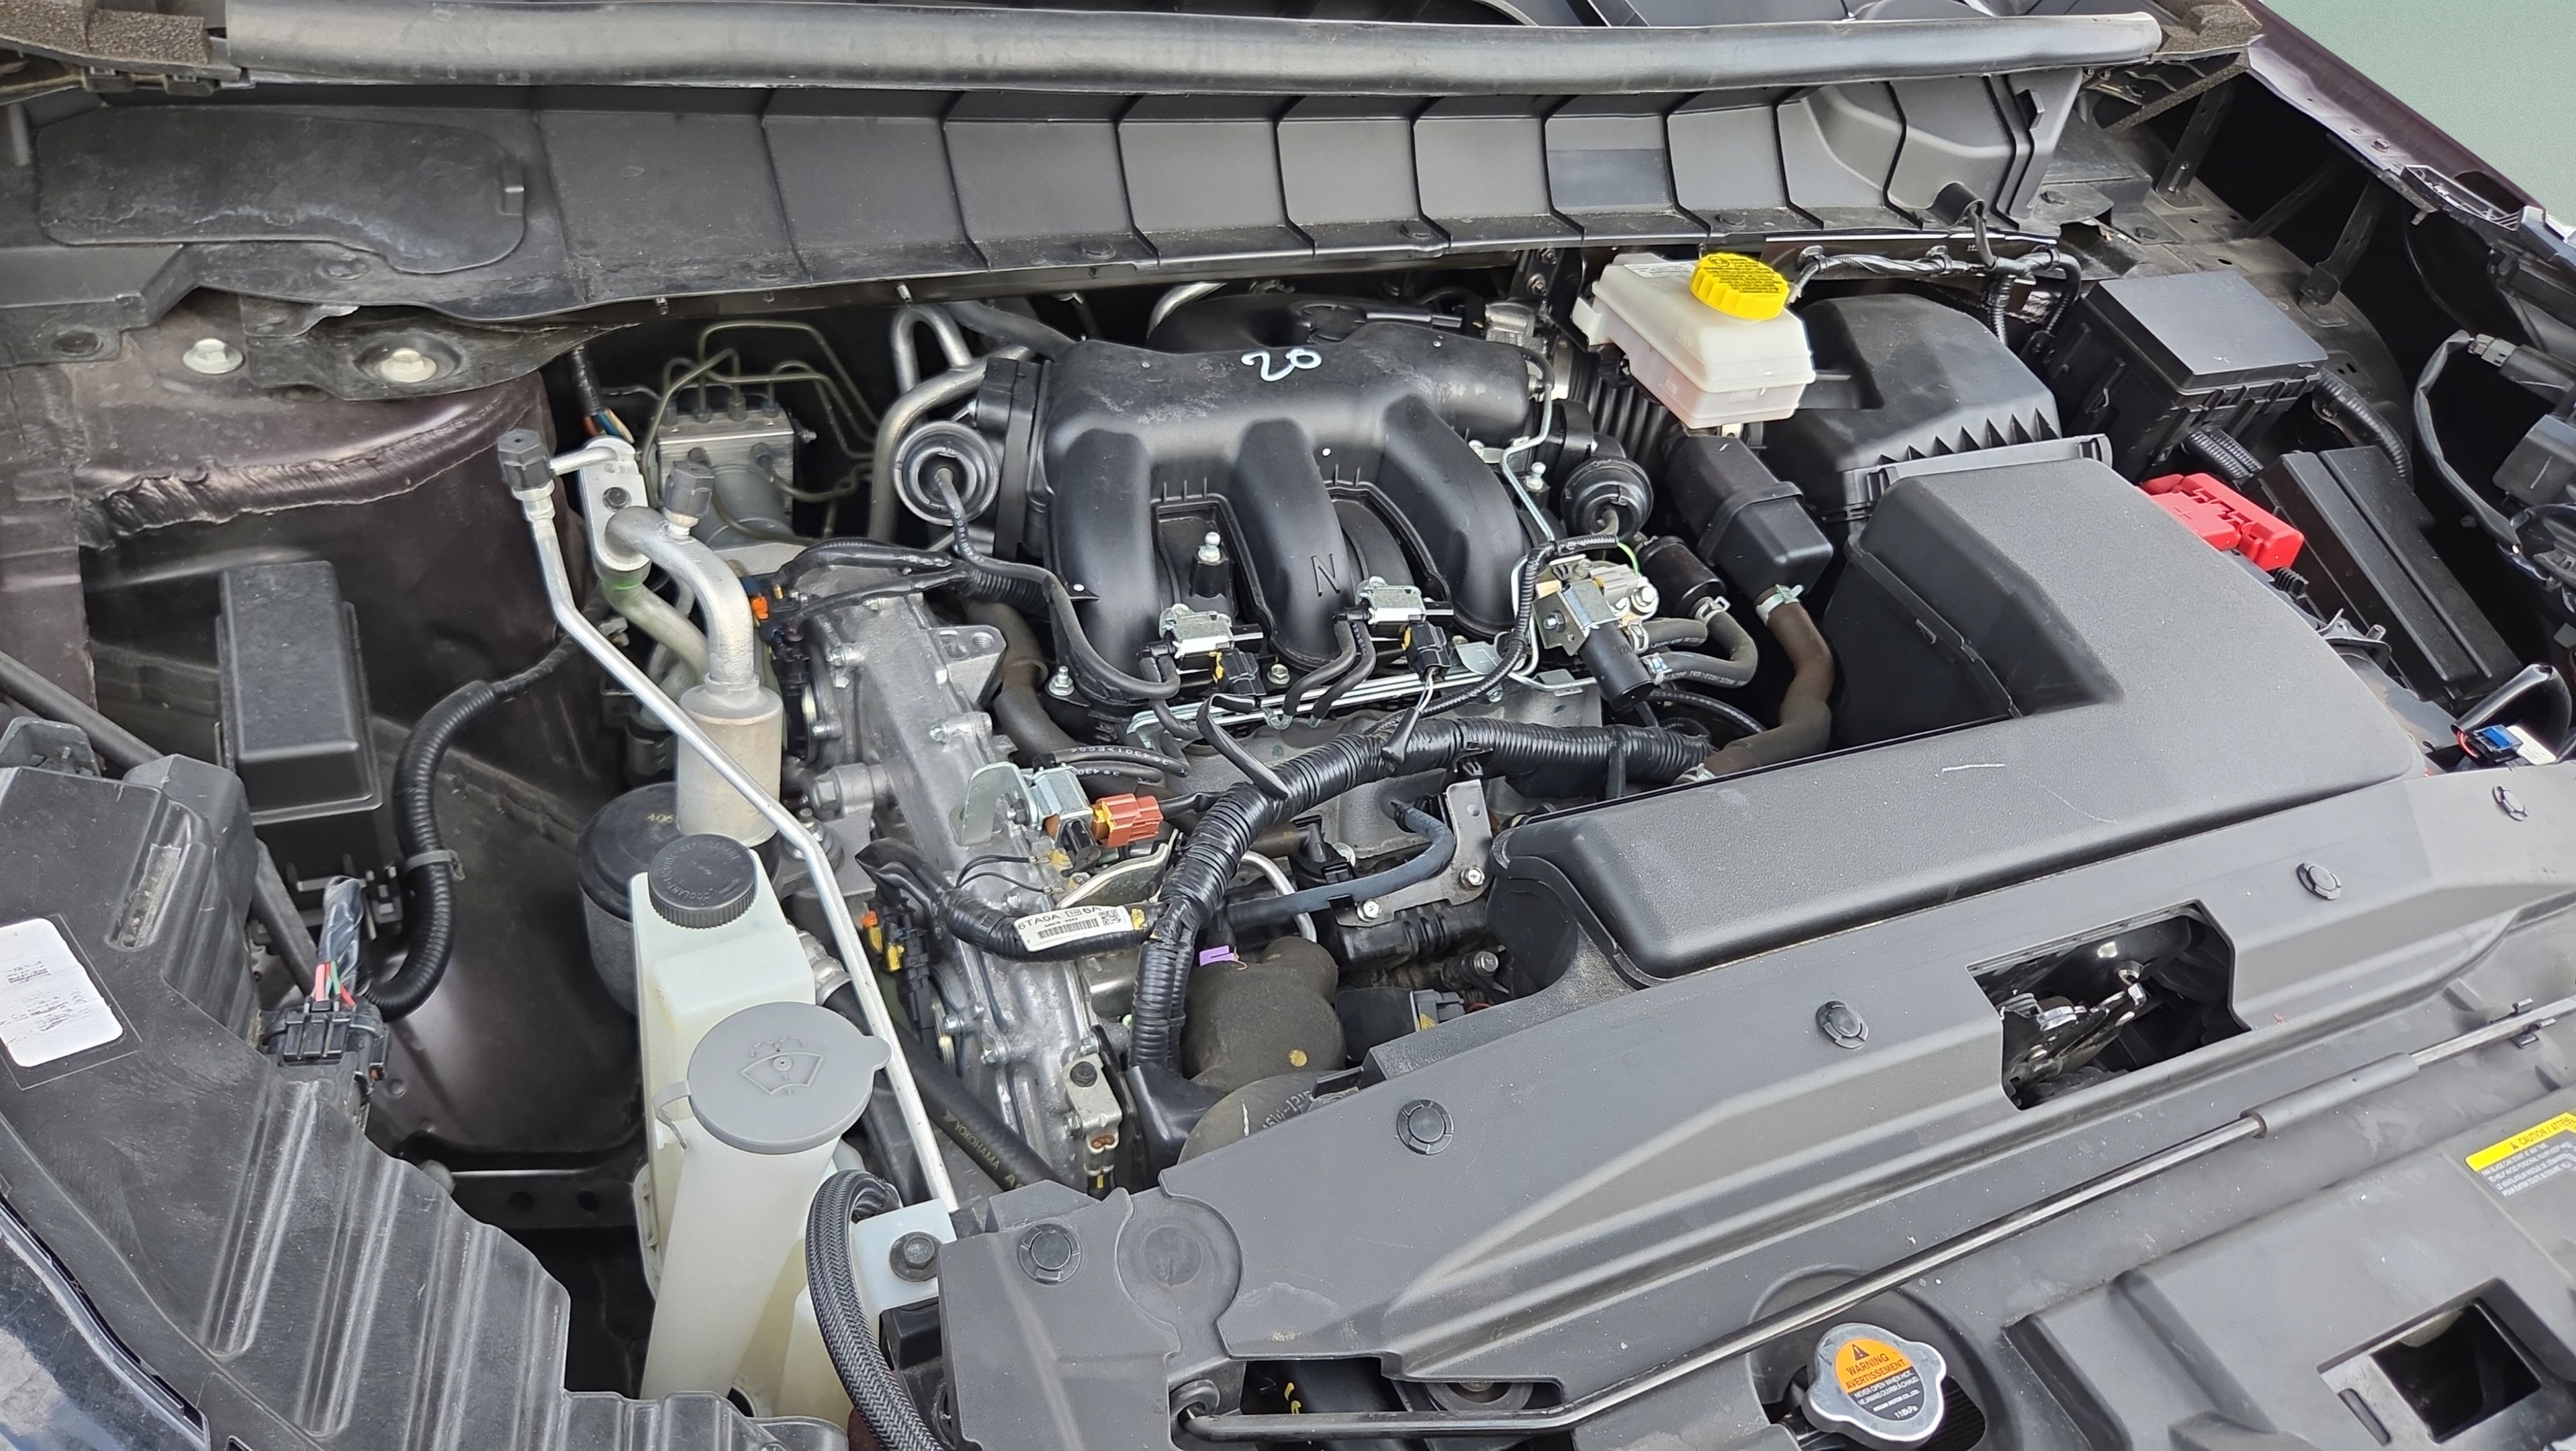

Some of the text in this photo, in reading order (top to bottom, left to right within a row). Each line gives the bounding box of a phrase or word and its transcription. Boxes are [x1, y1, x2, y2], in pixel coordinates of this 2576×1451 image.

[1241, 348, 1322, 382] 20
[1311, 554, 1340, 597] N
[954, 1121, 1000, 1170] YOKOHAMA
[2518, 1127, 2547, 1145] CAUTION
[1845, 1359, 1906, 1390] AVERTISSEMENT
[1846, 1353, 1890, 1376] WARNING
[1854, 1388, 1872, 1399] NEVER
[1870, 1382, 1886, 1392] OPEN
[1884, 1376, 1901, 1387] WHEN
